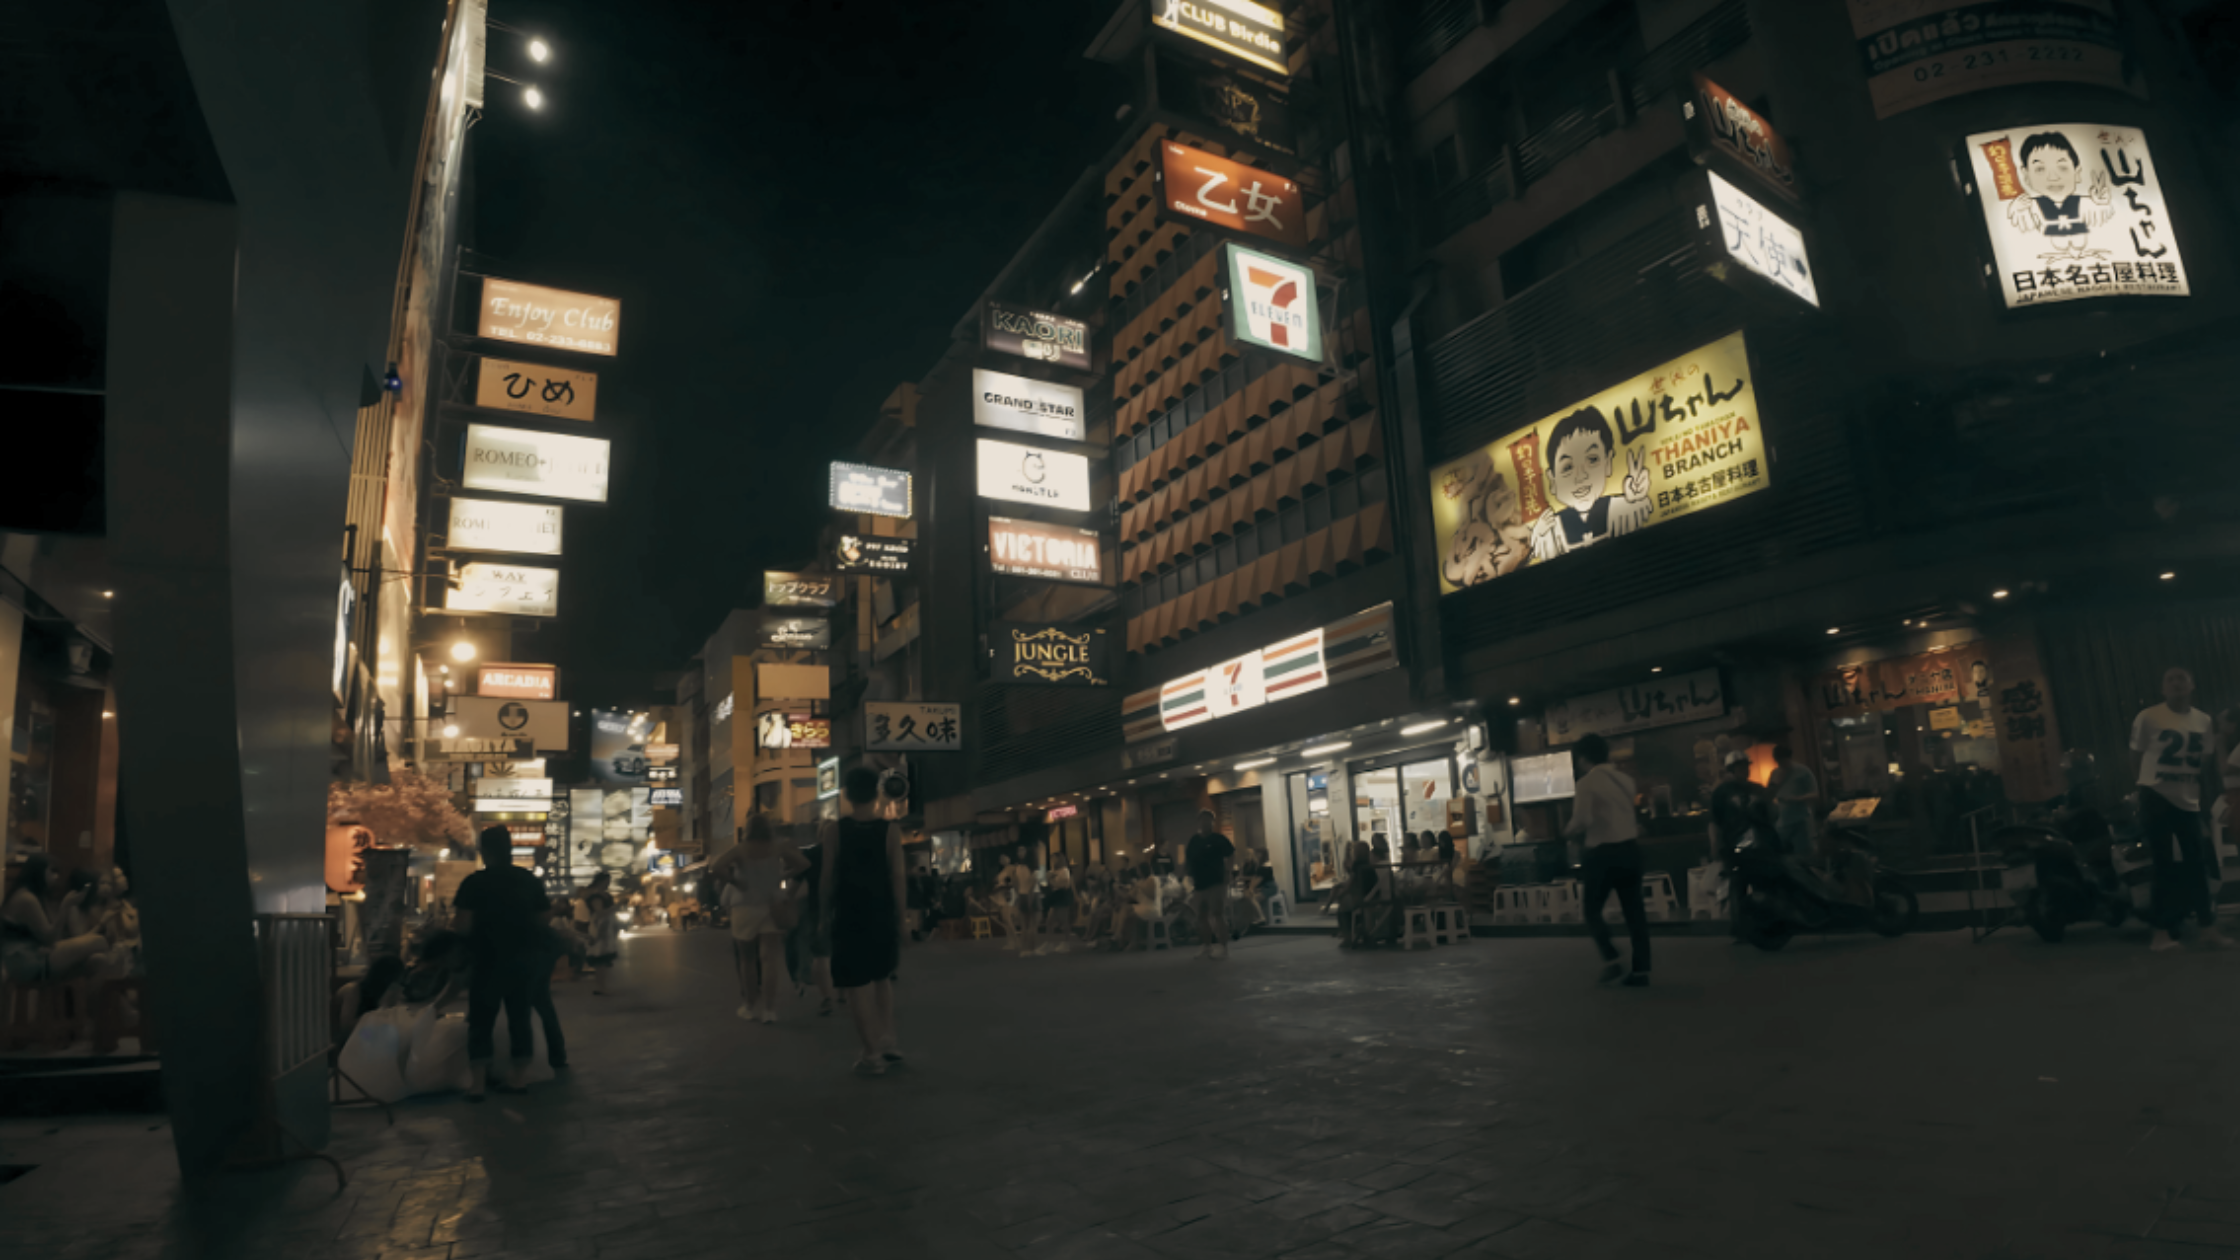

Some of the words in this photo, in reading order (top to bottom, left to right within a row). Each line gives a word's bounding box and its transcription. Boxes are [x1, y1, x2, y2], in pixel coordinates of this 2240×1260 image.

[1180, 2, 1226, 32] CLUB
[1228, 20, 1281, 54] Birdie
[1914, 46, 2085, 82] 02-231-2222
[1193, 165, 1284, 231] 乙女
[2100, 147, 2168, 259] 山ちゃん
[2012, 261, 2180, 293] 日本名古屋料理
[490, 297, 557, 332] Enjoy
[563, 306, 614, 332] Club
[992, 309, 1085, 349] KAORI
[502, 372, 575, 405] ひめ
[983, 392, 1034, 410] GRAND
[1038, 401, 1075, 417] STAR
[1614, 372, 1745, 447] 山ちゃん
[1650, 416, 1751, 466] THANIYA
[1663, 437, 1744, 480] BRANCH
[994, 531, 1097, 569] VICTORIA
[1014, 643, 1090, 663] JUNGLE
[1618, 678, 1720, 723] 山ちゃん
[870, 713, 957, 745] 多久味
[2157, 728, 2204, 768] 25
